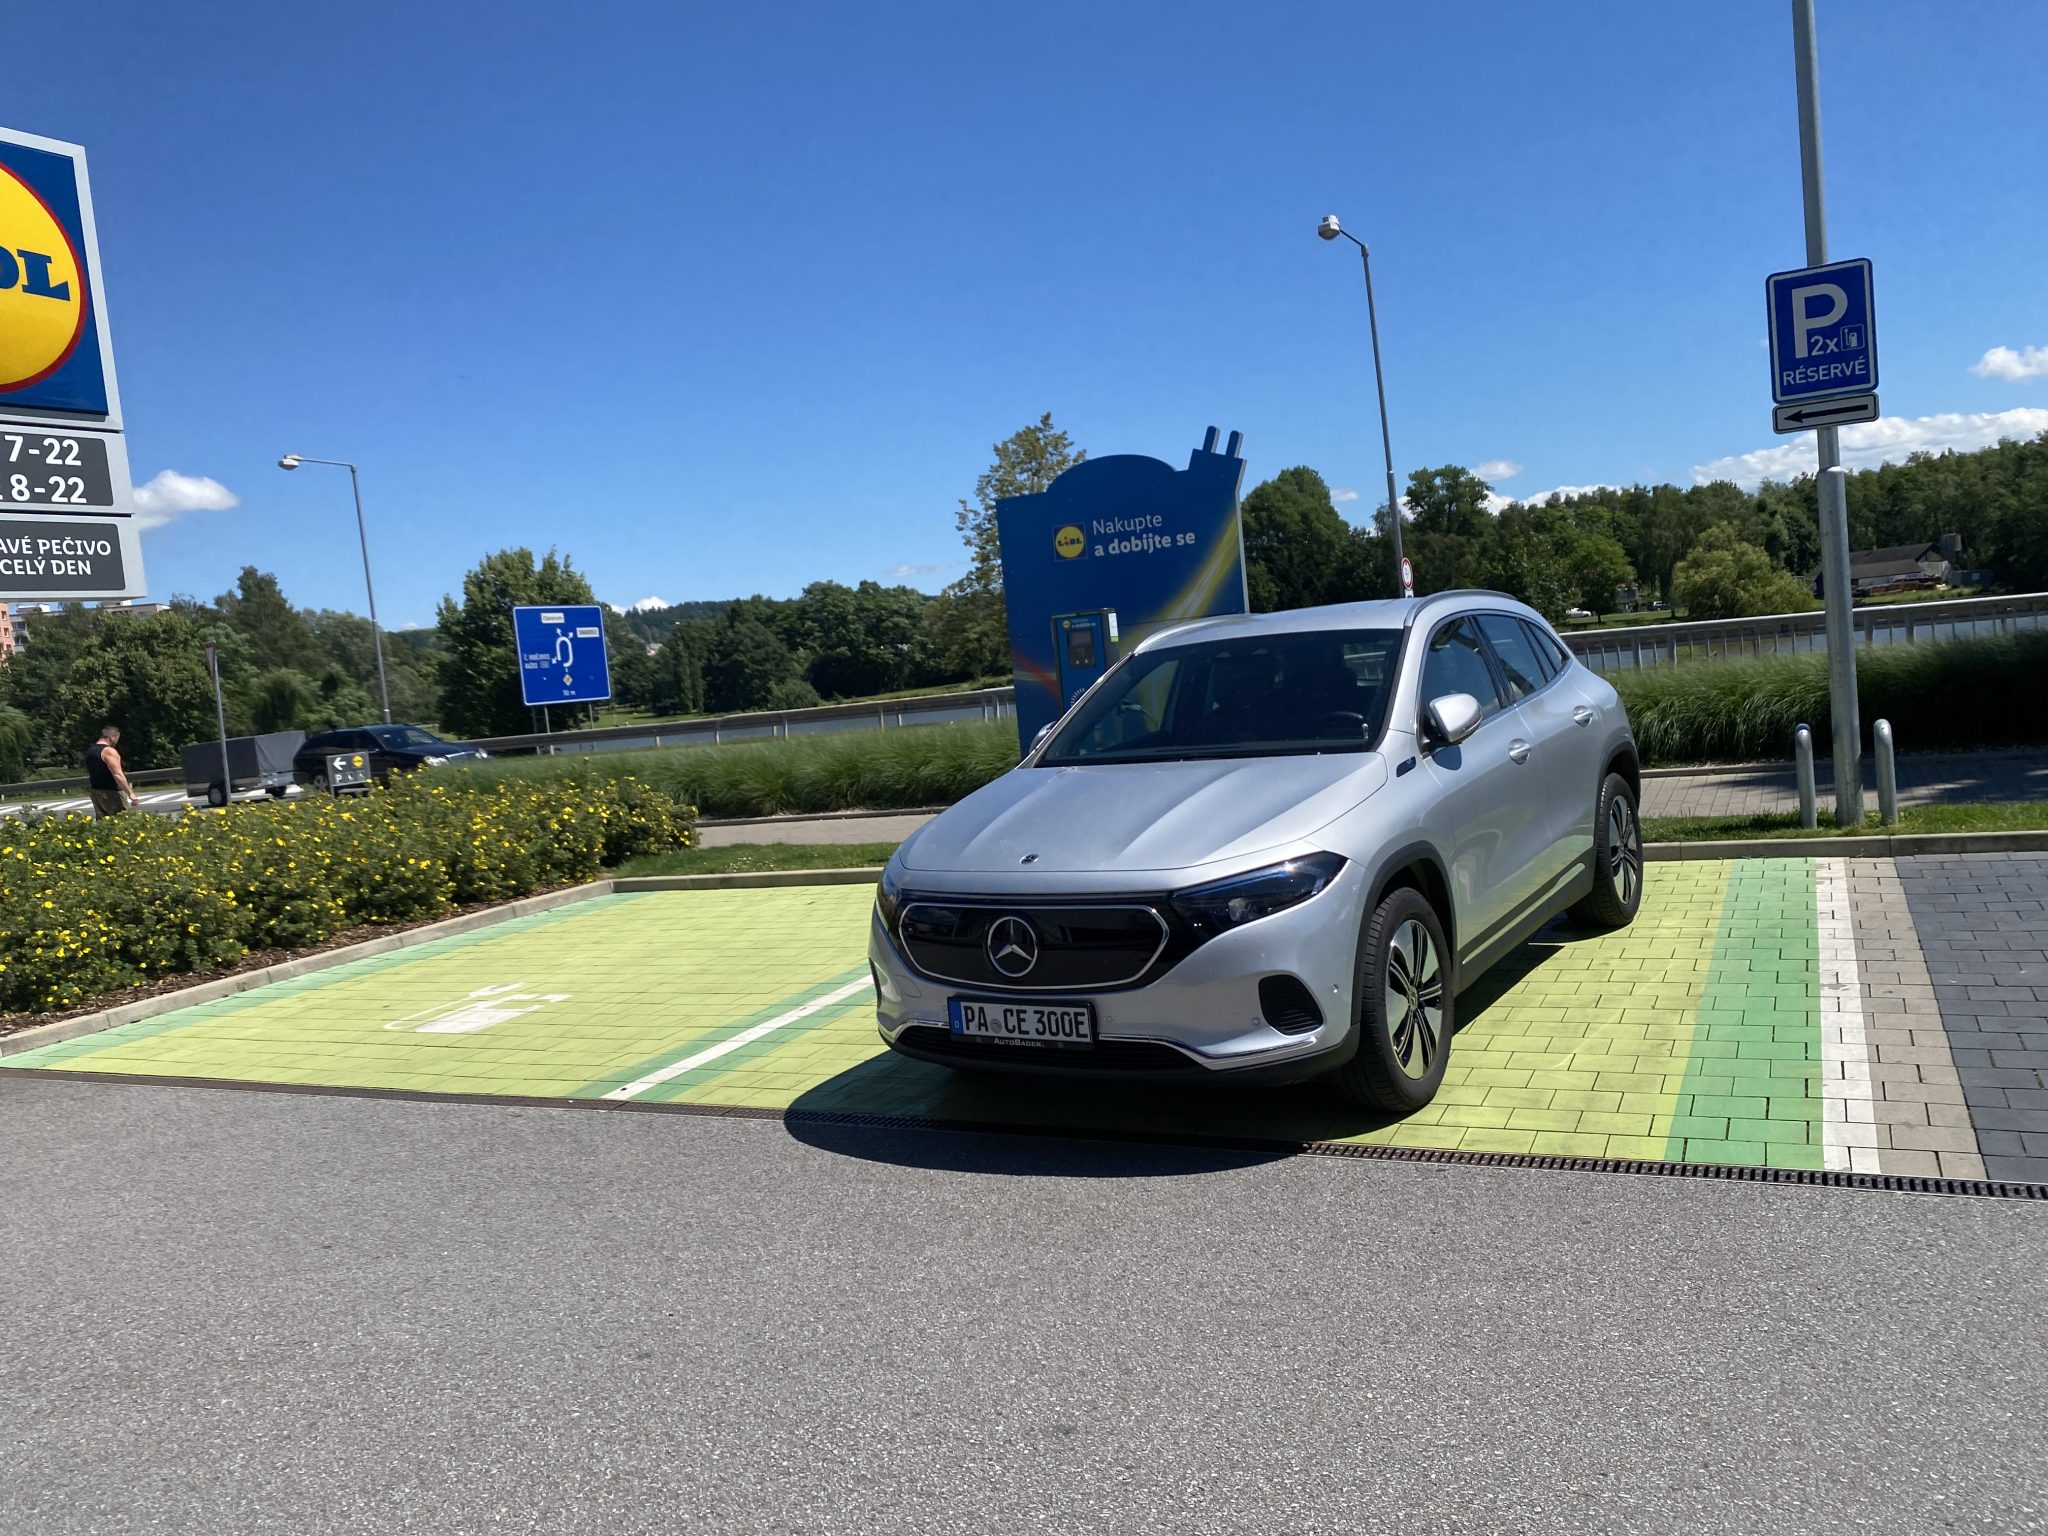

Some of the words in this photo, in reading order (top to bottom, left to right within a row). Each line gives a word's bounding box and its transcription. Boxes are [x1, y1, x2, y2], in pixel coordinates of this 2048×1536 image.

[1791, 283, 1849, 359] P
[1810, 335, 1839, 356] 2x
[1783, 355, 1867, 386] RÉSERVÉ
[1092, 514, 1162, 535] Nakupte
[37, 536, 111, 556] PEČIVO
[1057, 536, 1083, 547] LIDL
[1094, 545, 1105, 557] a
[1108, 533, 1172, 553] dobijte
[1176, 532, 1196, 546] se
[0, 556, 46, 575] CELÝ
[50, 559, 92, 575] DEN
[963, 1005, 989, 1032] PA
[1003, 1008, 1030, 1036] CE
[1033, 1010, 1089, 1038] 300E
